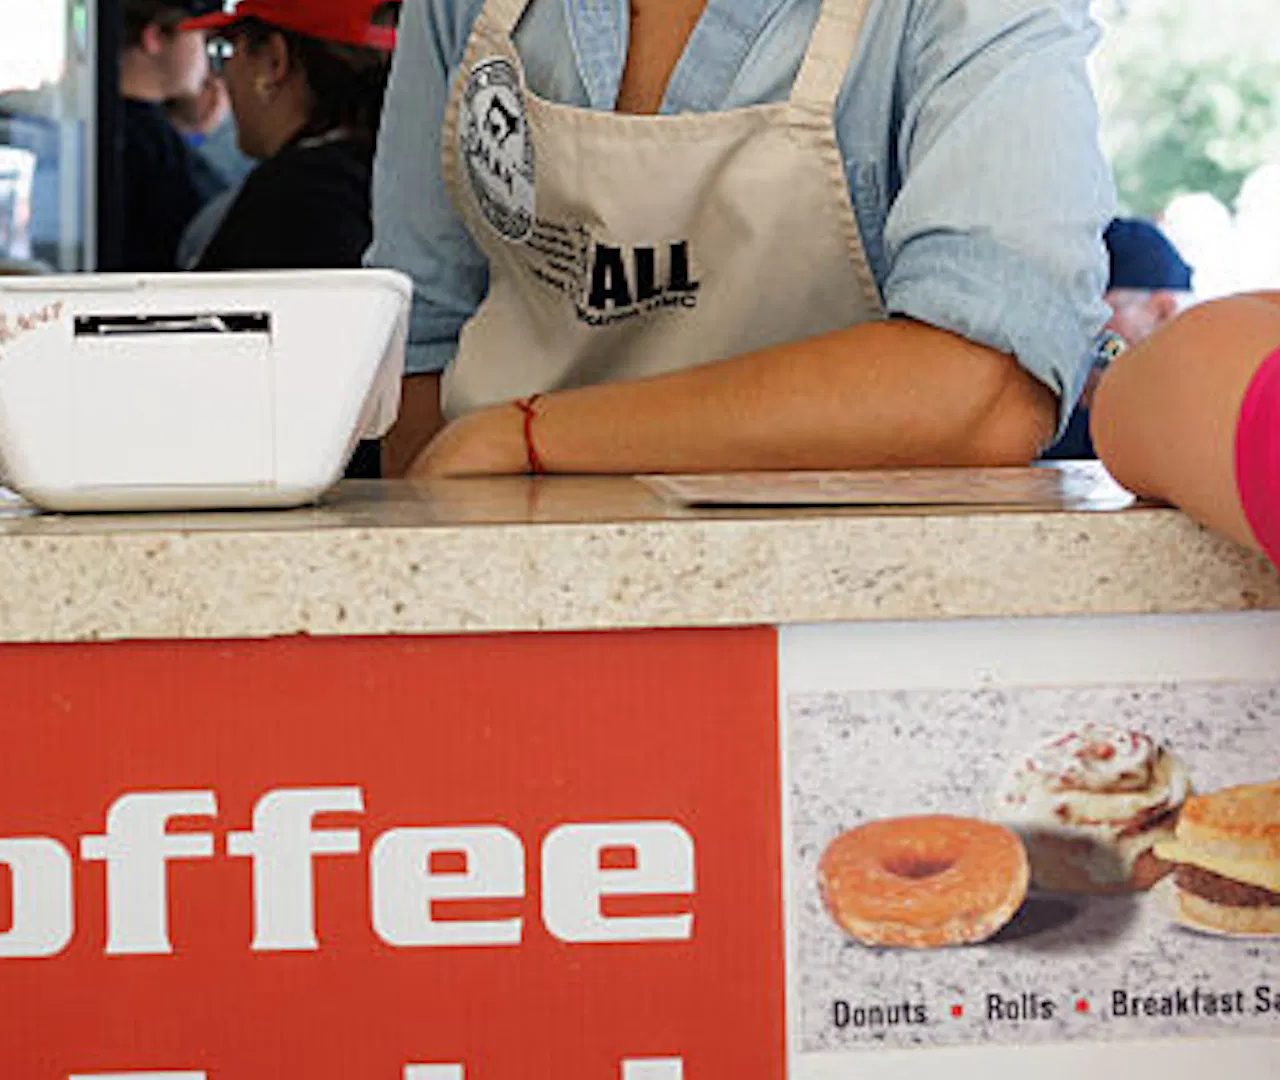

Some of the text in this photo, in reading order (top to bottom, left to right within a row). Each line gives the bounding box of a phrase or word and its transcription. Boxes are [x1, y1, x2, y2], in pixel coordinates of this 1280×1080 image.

[834, 1000, 928, 1028] Donuts
[987, 993, 1057, 1020] Rolls
[1111, 989, 1245, 1017] Breakfast
